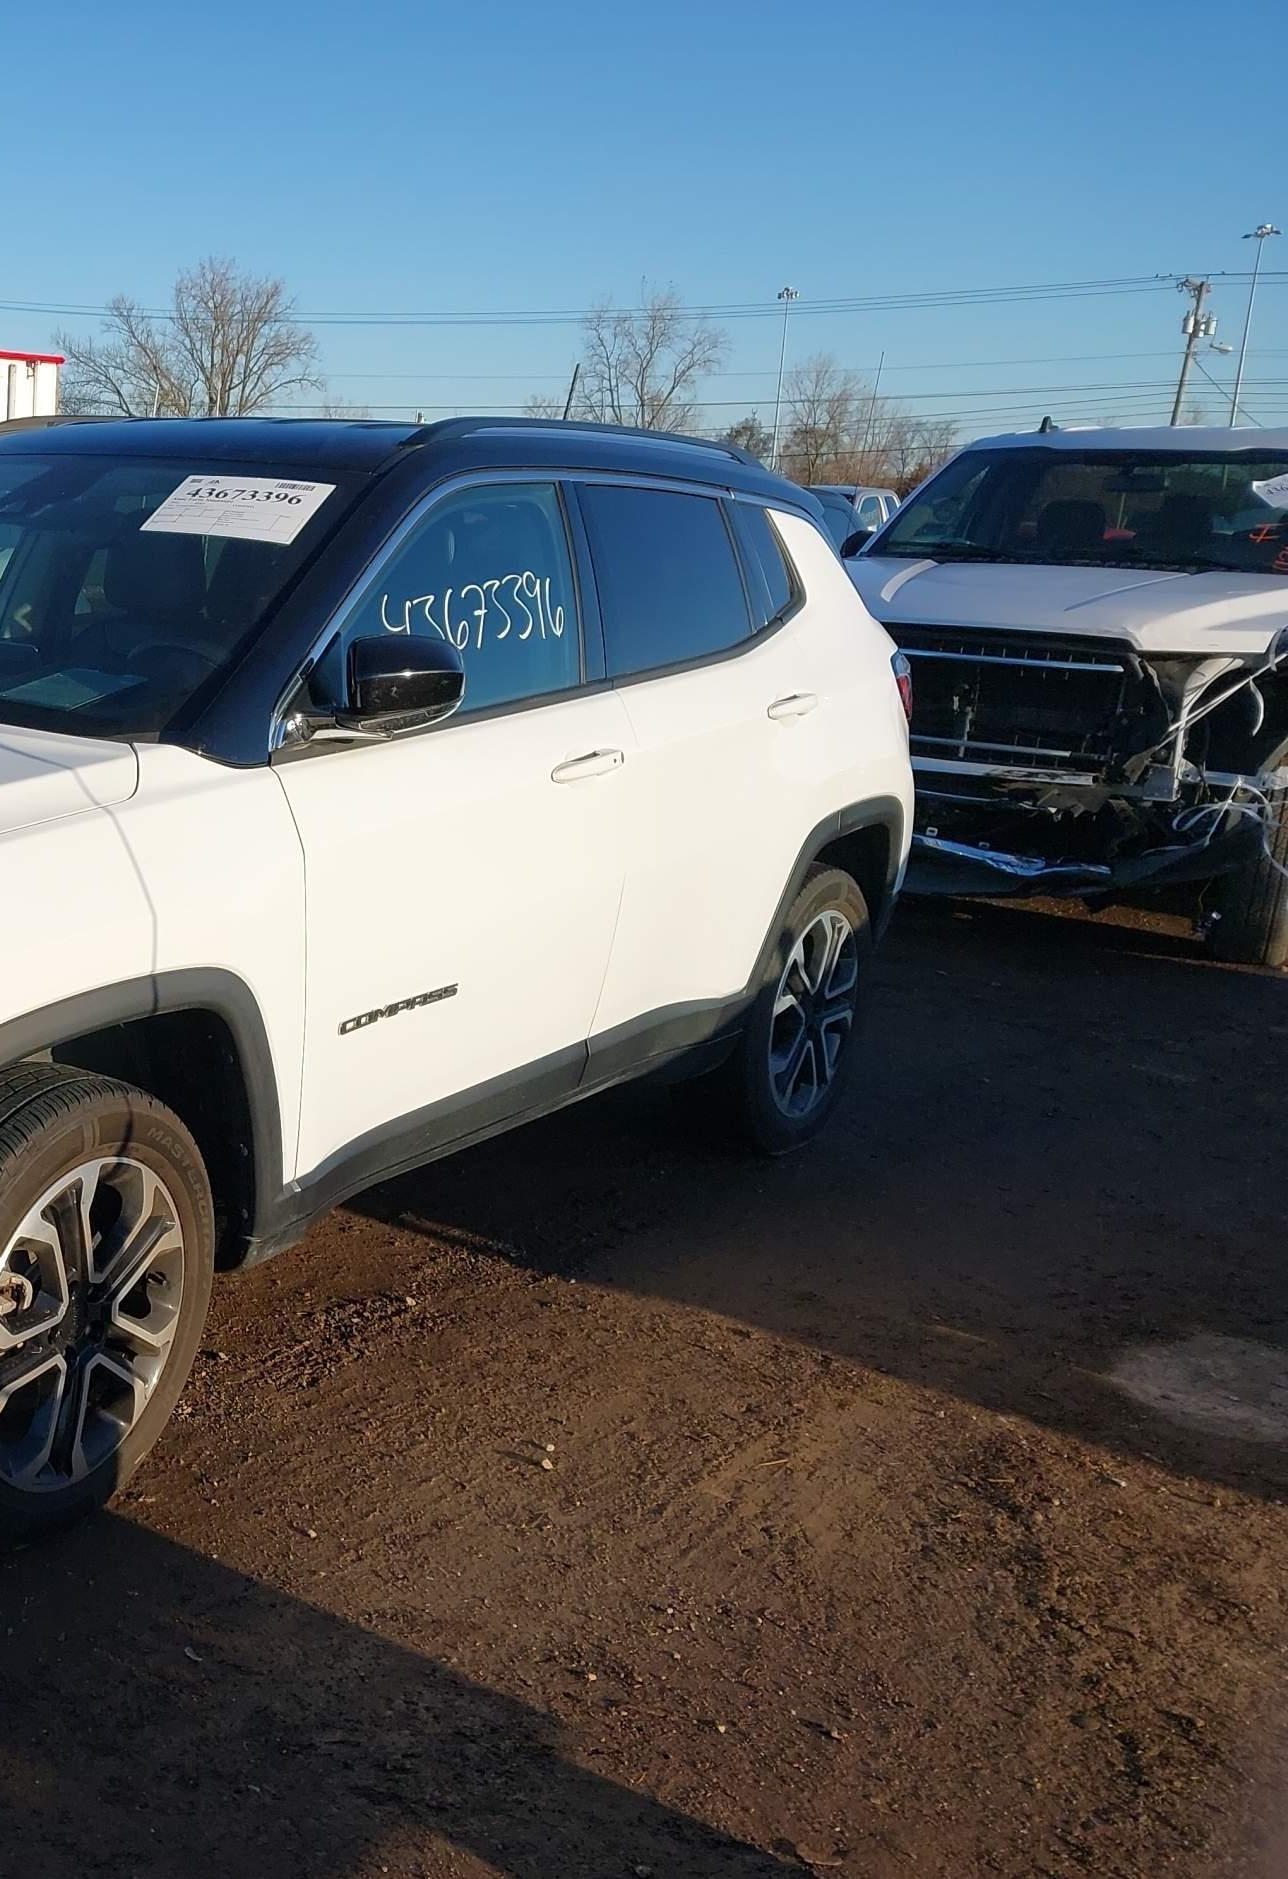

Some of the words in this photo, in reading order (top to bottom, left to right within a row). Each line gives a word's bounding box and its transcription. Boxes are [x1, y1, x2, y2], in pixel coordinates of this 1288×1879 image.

[186, 487, 306, 506] 43673396
[381, 571, 564, 650] 43673396
[338, 982, 459, 1036] COMPASS
